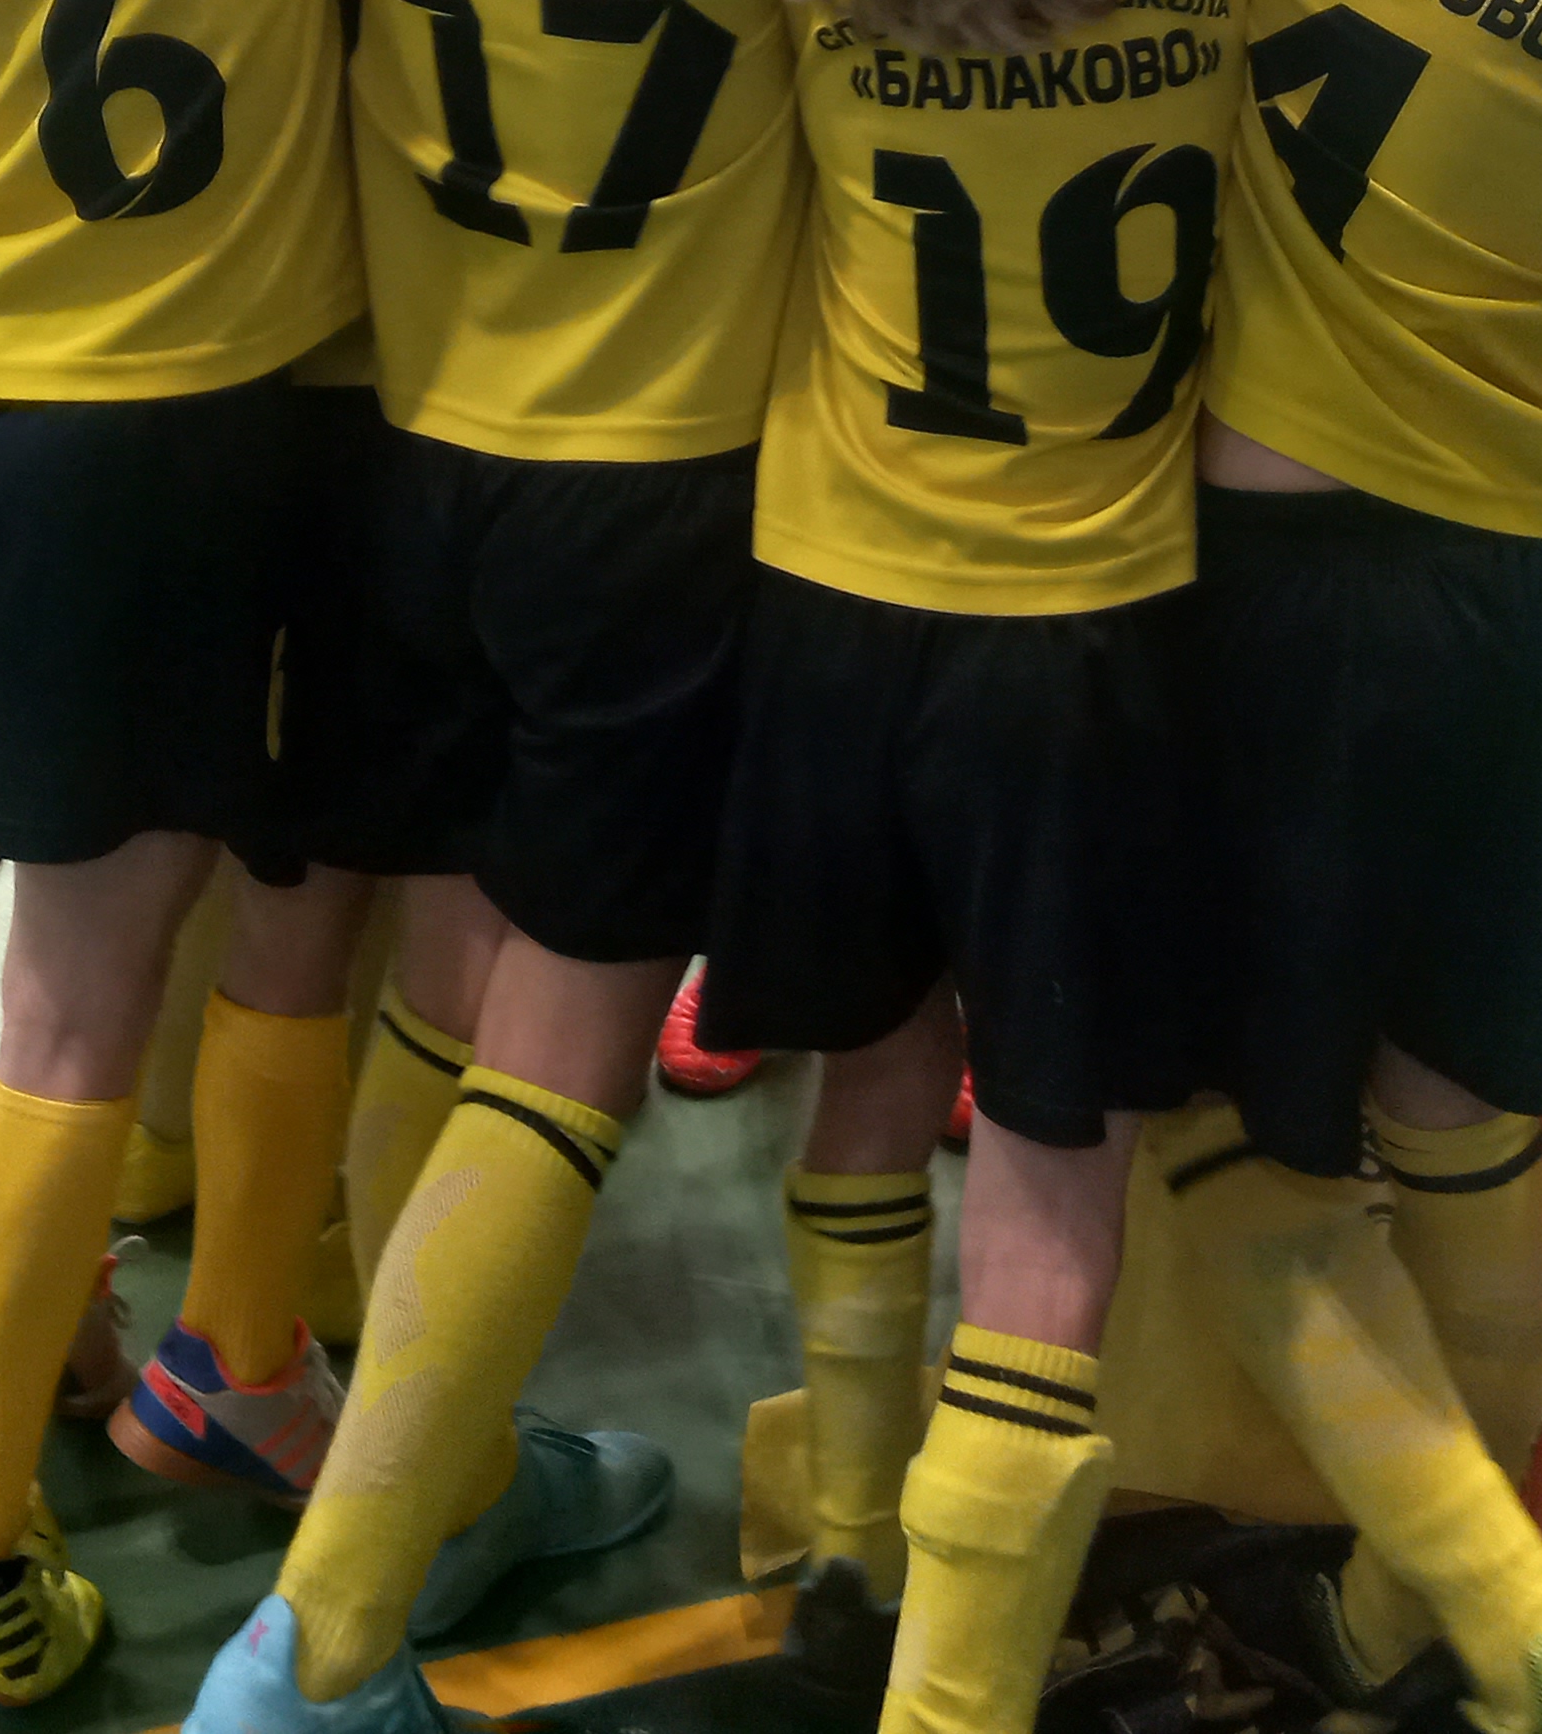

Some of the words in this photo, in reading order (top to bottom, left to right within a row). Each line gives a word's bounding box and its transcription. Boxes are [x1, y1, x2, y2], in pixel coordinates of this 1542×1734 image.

[850, 27, 1222, 111] «БАЛАКОВО»
[1247, 3, 1432, 264] 4
[872, 142, 1219, 447] 19
